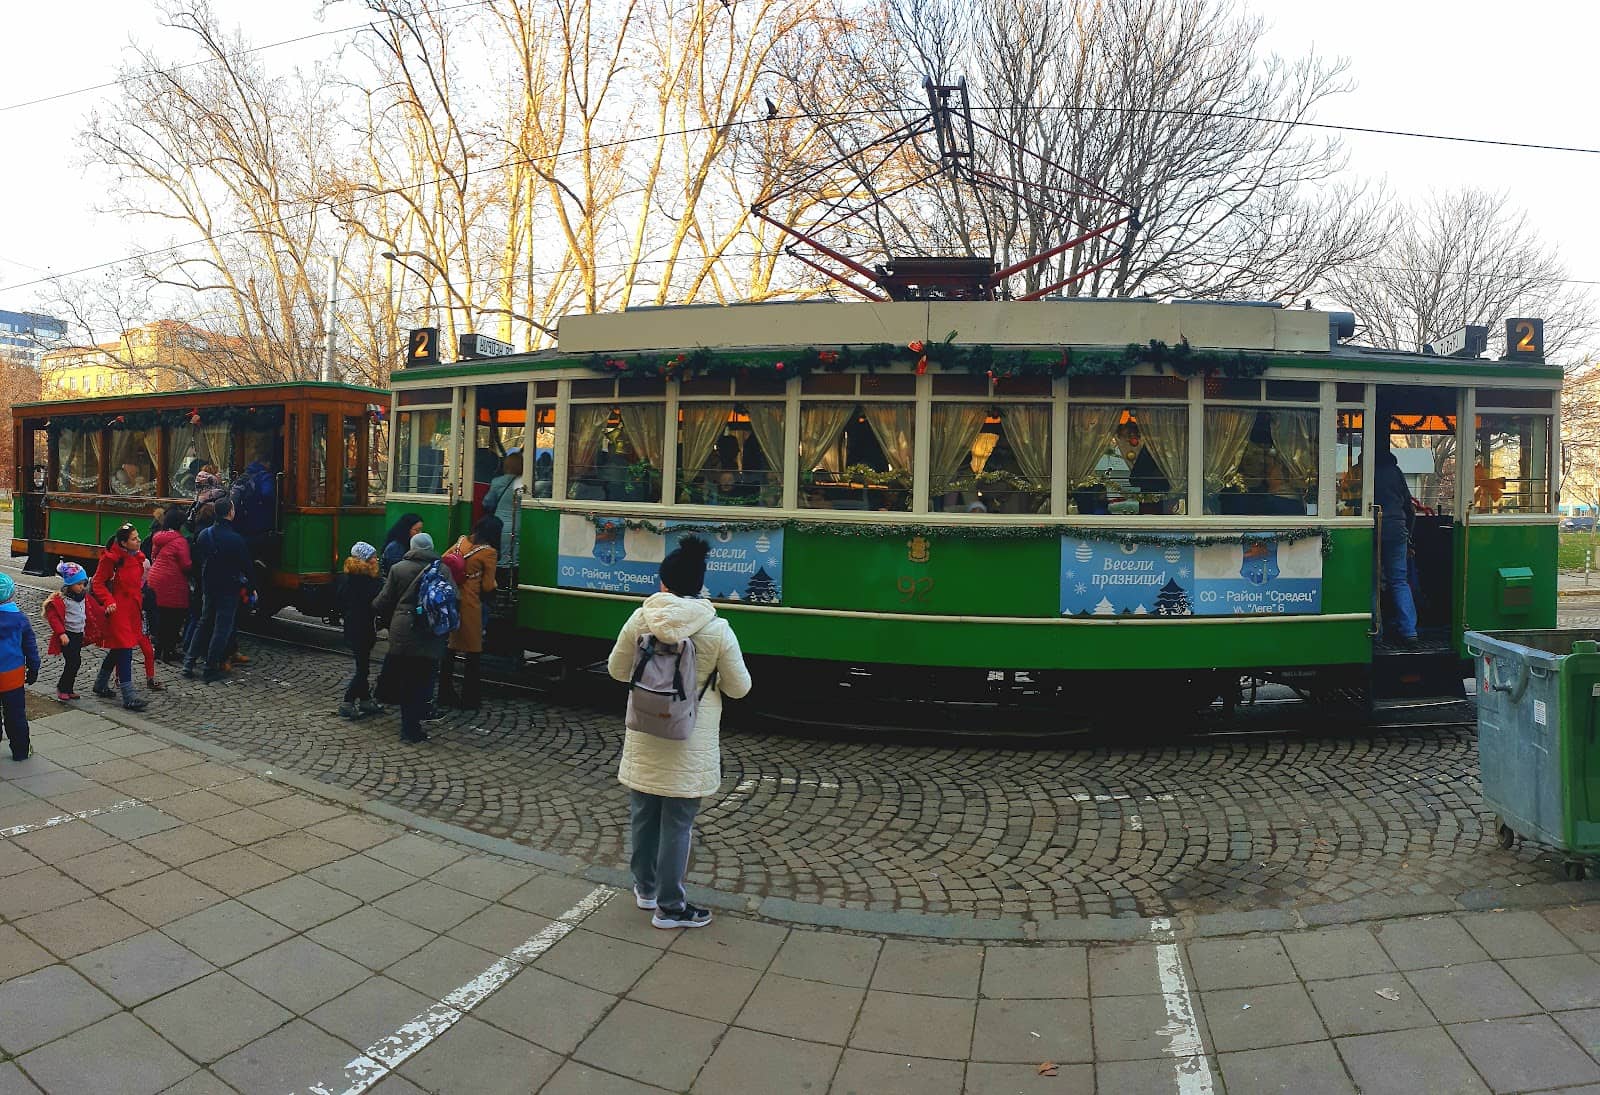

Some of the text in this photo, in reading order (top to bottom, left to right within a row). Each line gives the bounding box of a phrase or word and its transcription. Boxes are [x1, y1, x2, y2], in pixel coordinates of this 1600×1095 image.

[1515, 321, 1536, 352] 2
[414, 331, 429, 358] 2
[705, 548, 748, 560] есели
[705, 560, 756, 574] азници!
[1103, 557, 1154, 571] Весели
[561, 566, 575, 577] СО
[581, 567, 611, 580] Район
[1091, 571, 1166, 589] празници!
[624, 583, 630, 592] 6
[897, 576, 935, 603] 92
[1199, 590, 1217, 602] СО
[1226, 590, 1263, 602] Район
[1278, 603, 1285, 613] 6
